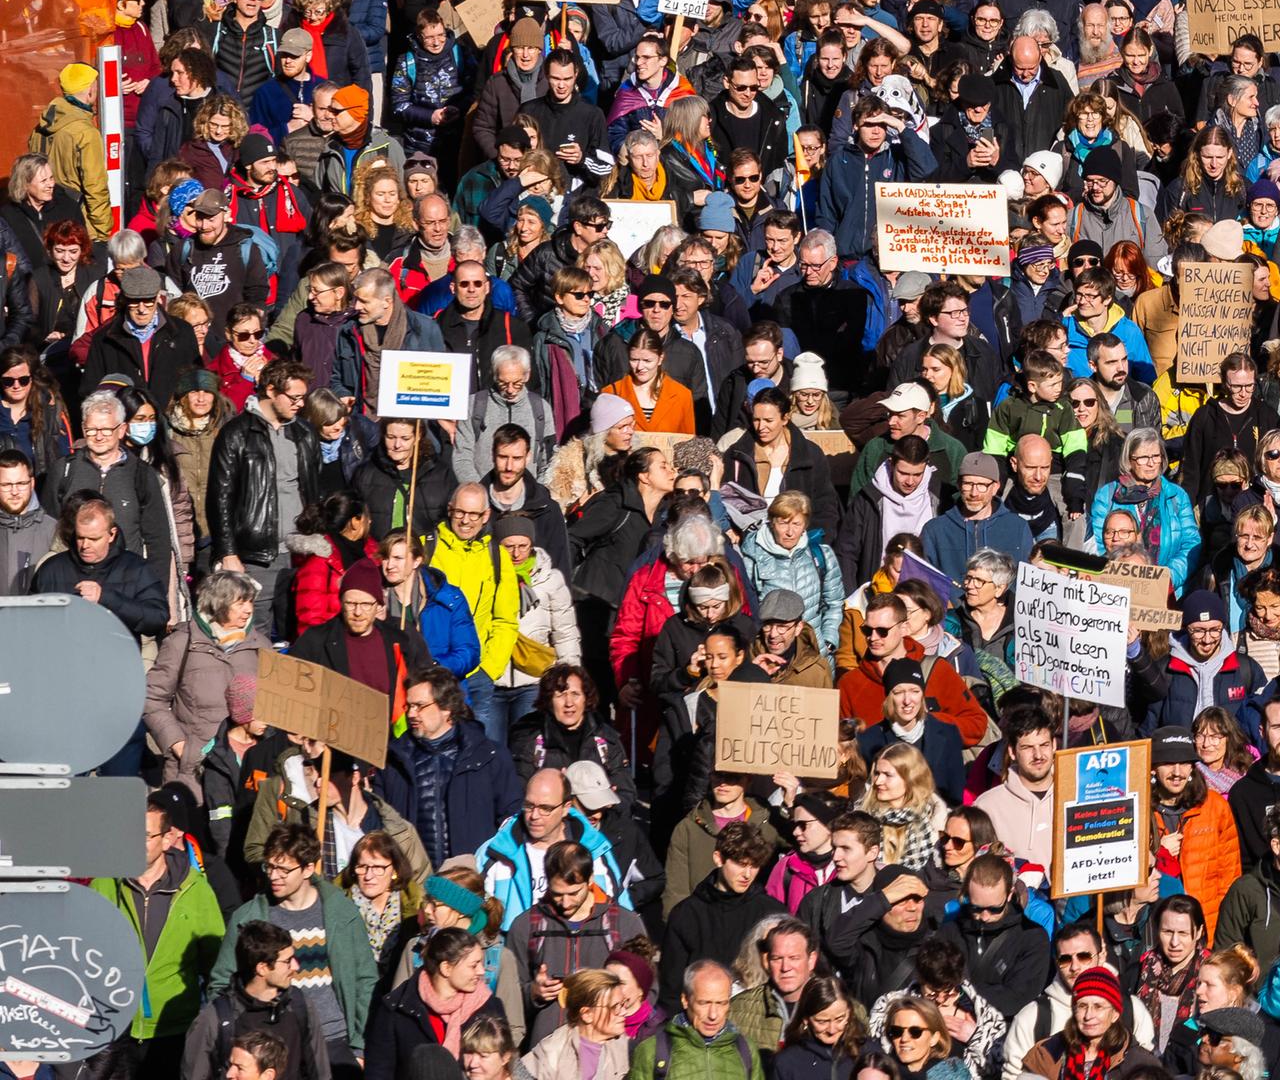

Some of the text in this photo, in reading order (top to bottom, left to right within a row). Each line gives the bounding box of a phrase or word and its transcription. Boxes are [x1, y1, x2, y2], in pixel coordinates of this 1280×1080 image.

[664, 0, 678, 10] zu
[1191, 31, 1215, 45] AUCH
[889, 243, 988, 257] 2018 nicht wieder
[923, 254, 969, 268] möglich
[1185, 268, 1242, 285] BRAUNE
[1194, 287, 1251, 304] FLASCHEN
[1182, 340, 1211, 357] NICHT
[1020, 569, 1057, 594] Lieber
[1064, 583, 1085, 604] mit
[1087, 584, 1127, 608] Besen
[1018, 624, 1107, 659] als zu lesen
[753, 694, 801, 714] ALICE
[750, 716, 822, 740] HASST
[721, 737, 837, 769] DEUTSCHLAND
[1086, 753, 1121, 770] AfD
[1071, 855, 1132, 869] AFD-Verbot
[1088, 870, 1115, 883] jetzt!
